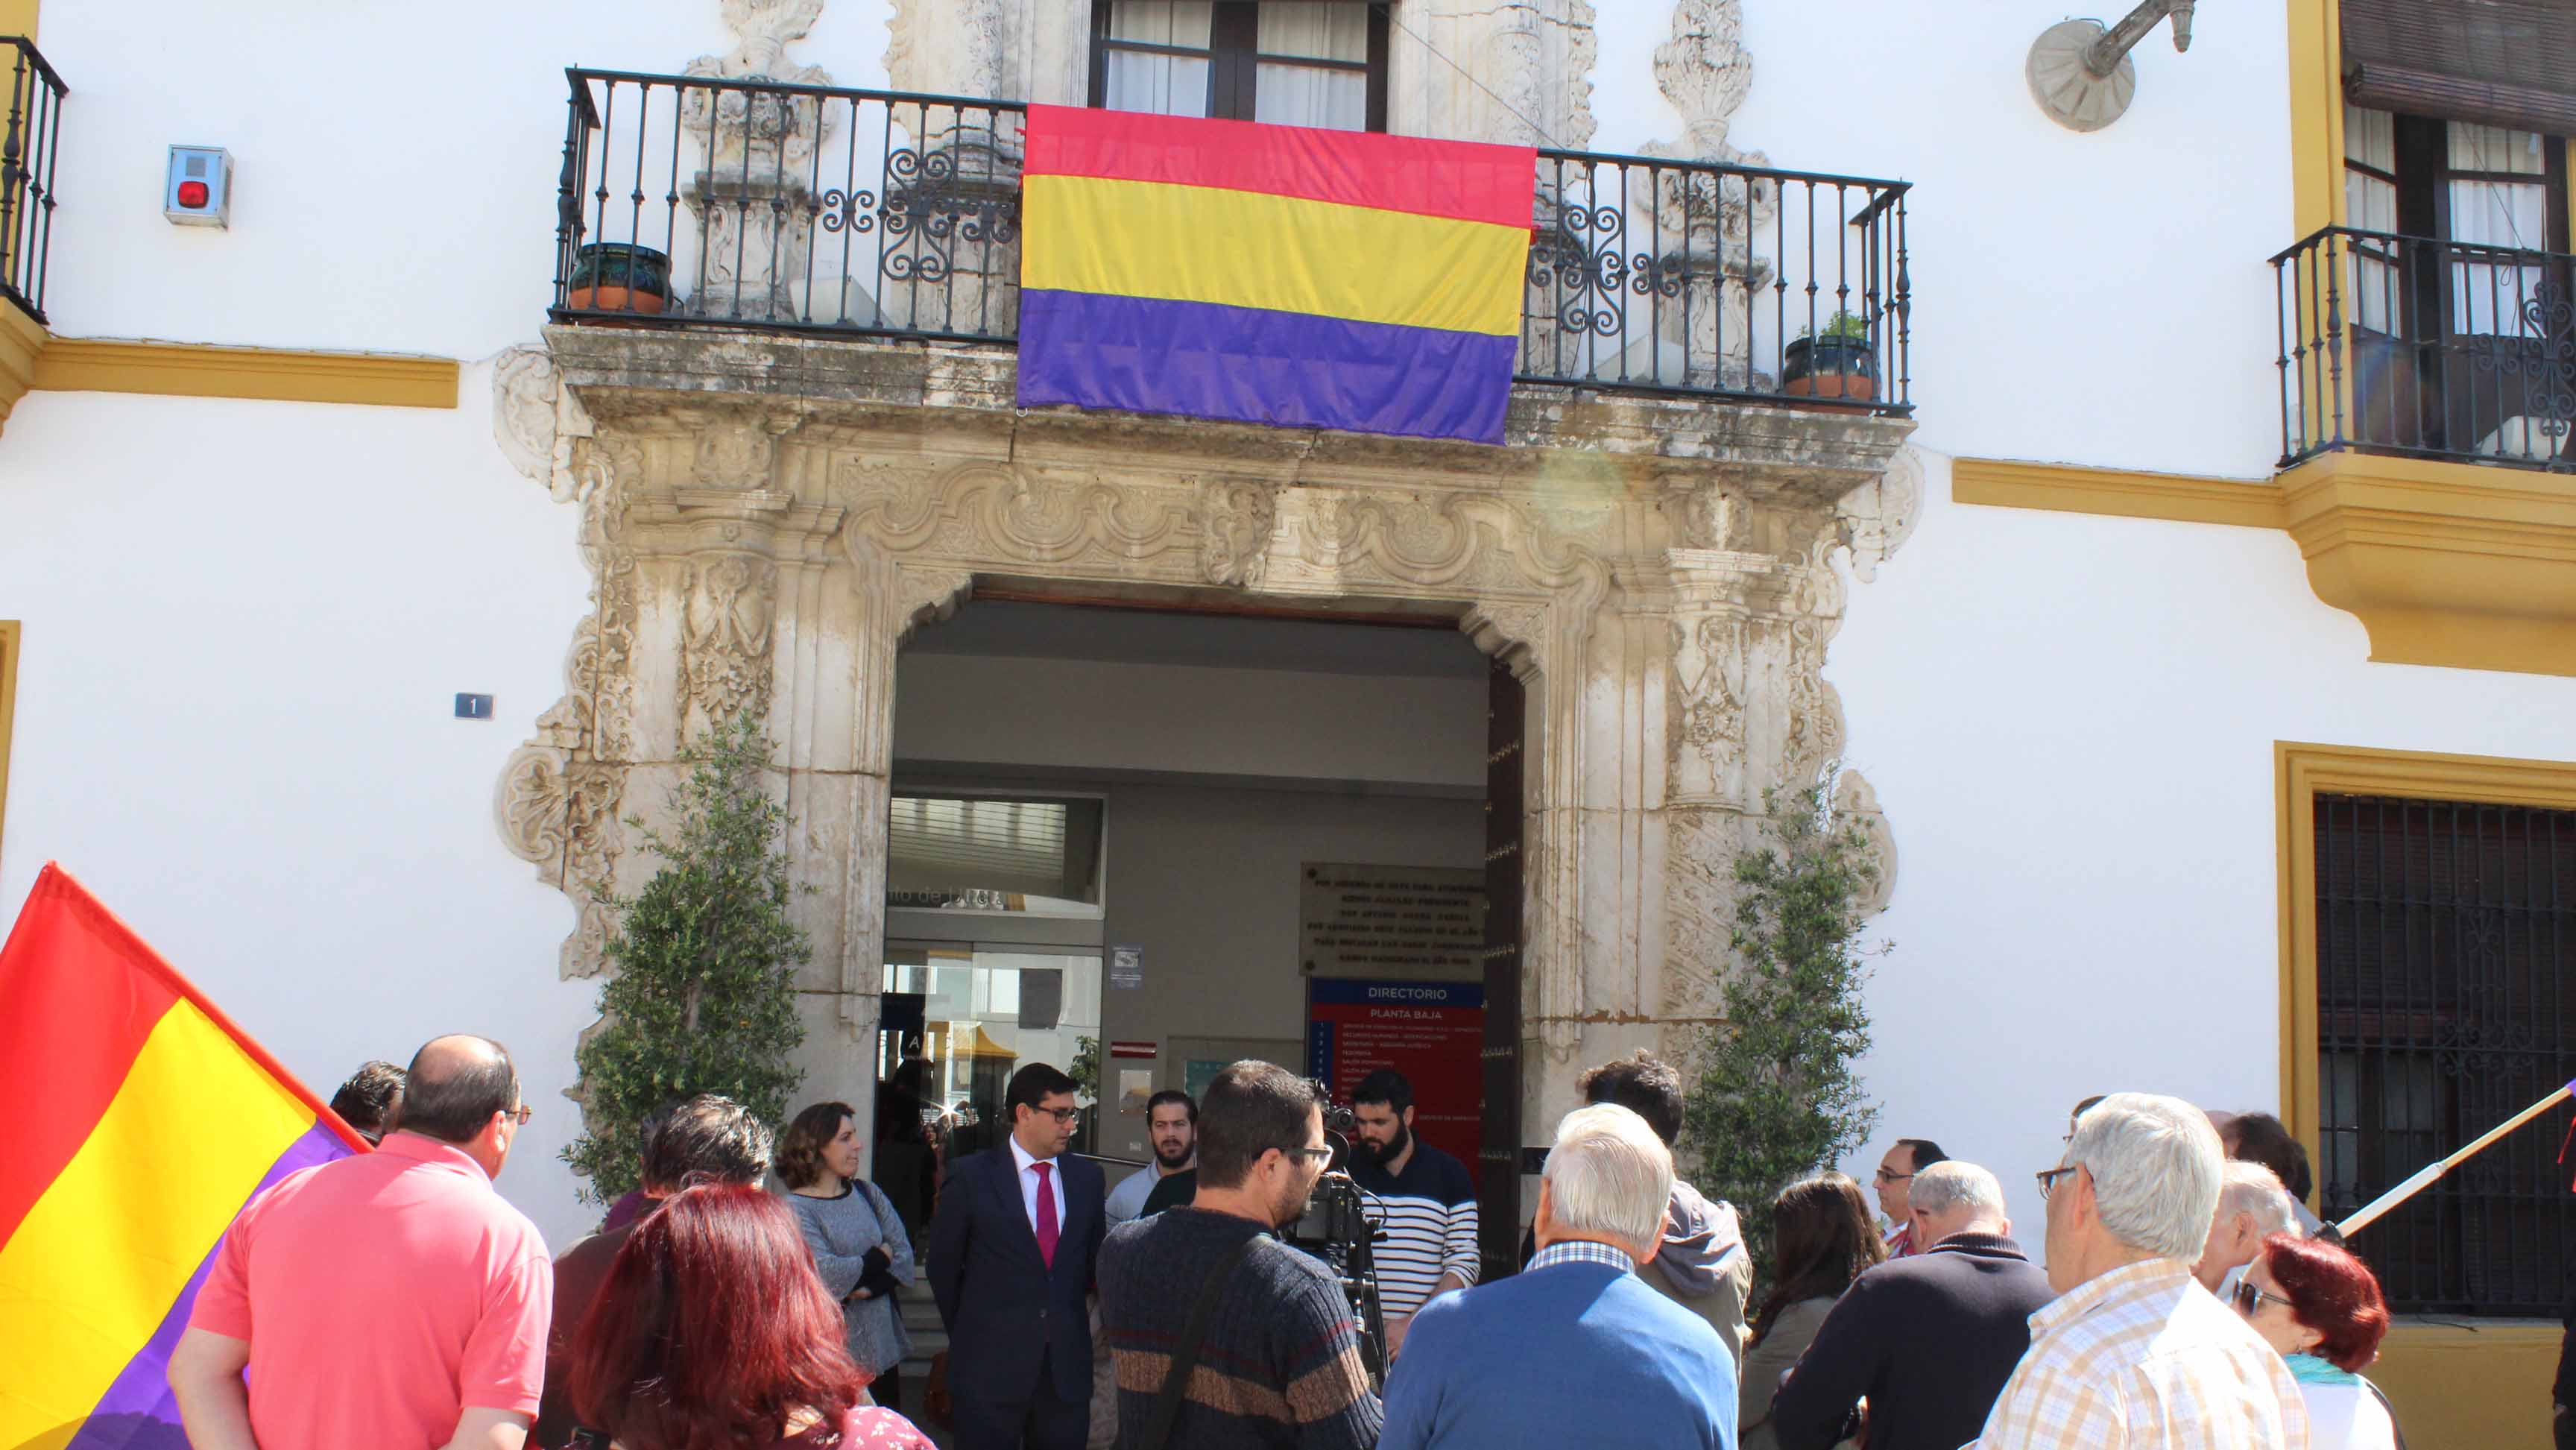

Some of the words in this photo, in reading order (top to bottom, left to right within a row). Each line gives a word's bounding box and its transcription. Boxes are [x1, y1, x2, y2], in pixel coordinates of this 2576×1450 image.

[470, 698, 477, 715] 1
[918, 885, 941, 903] de
[1368, 986, 1448, 1000] DIRECTORIO
[1370, 1008, 1411, 1019] PLANTA
[1413, 1009, 1442, 1021] BAJA
